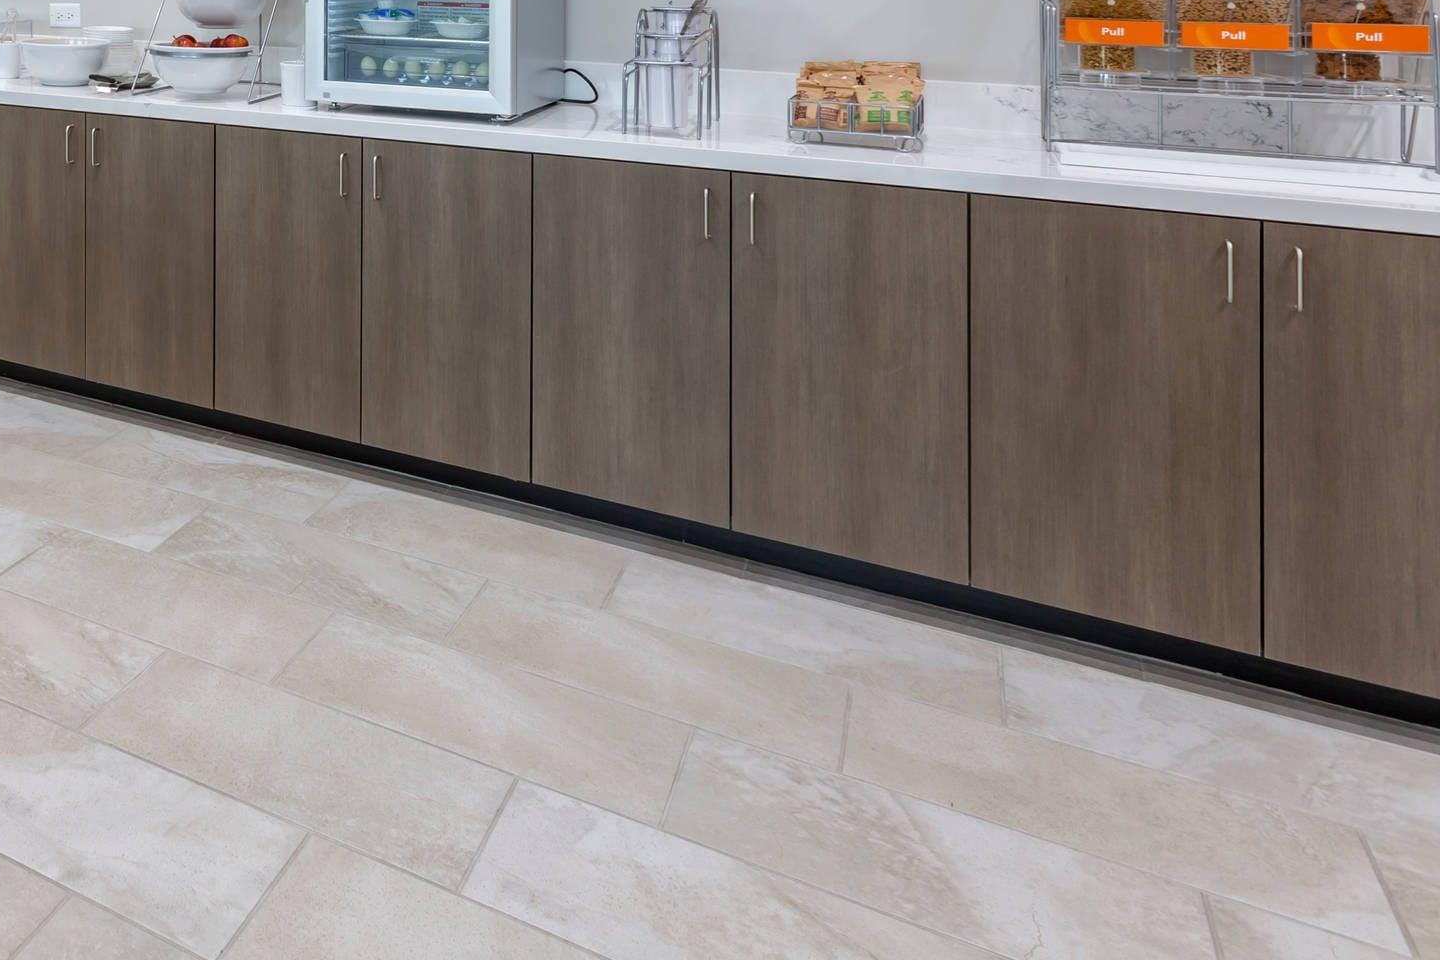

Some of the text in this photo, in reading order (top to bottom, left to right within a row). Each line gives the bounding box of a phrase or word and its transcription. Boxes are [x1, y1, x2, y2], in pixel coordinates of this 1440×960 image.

[1101, 27, 1125, 36] Pull
[1221, 31, 1246, 40] Pull
[1356, 32, 1383, 42] Pull
